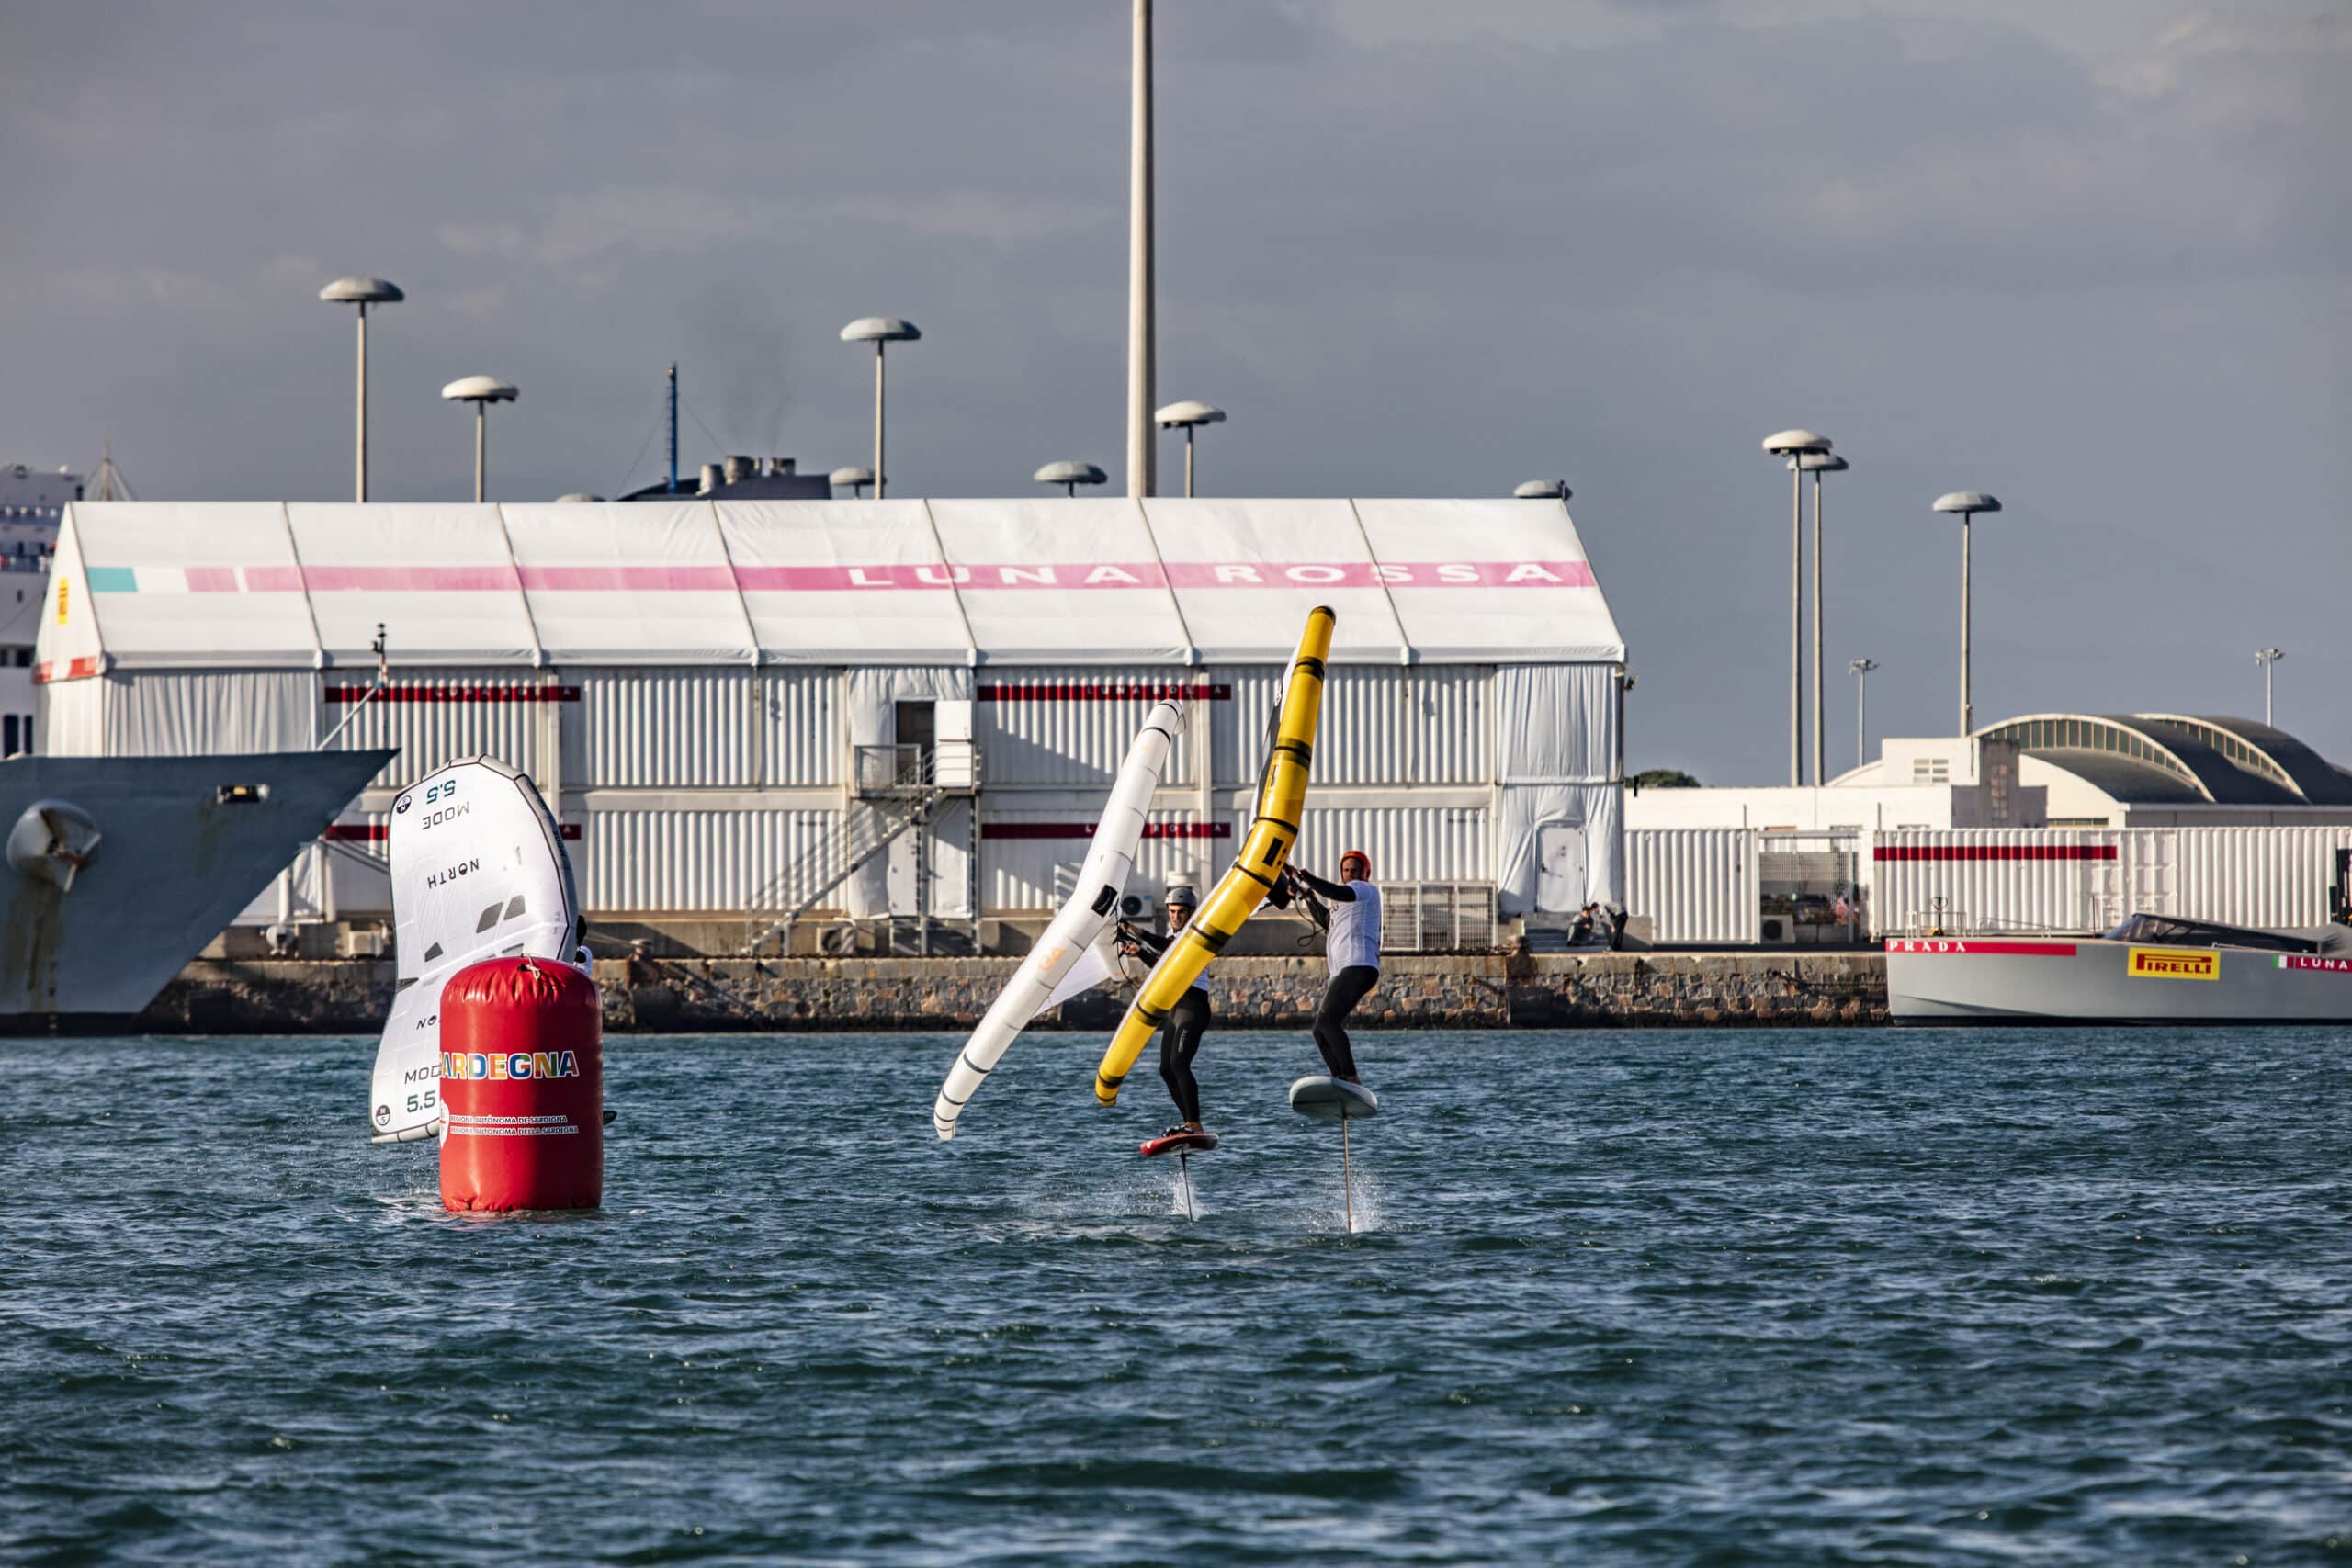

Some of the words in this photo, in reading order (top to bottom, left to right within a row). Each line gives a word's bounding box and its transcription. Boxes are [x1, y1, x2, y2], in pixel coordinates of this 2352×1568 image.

[848, 565, 1142, 586] LUNA
[1214, 563, 1563, 583] ROSSA
[426, 779, 456, 805] 5.5
[422, 801, 469, 830] MODE
[427, 858, 480, 889] NORTH
[1889, 941, 1965, 953] PRADA
[2136, 953, 2212, 974] PIRELLI
[2300, 957, 2348, 971] LUNA
[404, 1065, 441, 1084] MOD
[440, 1051, 580, 1080] ARDEGNA
[406, 1089, 435, 1112] 5.5
